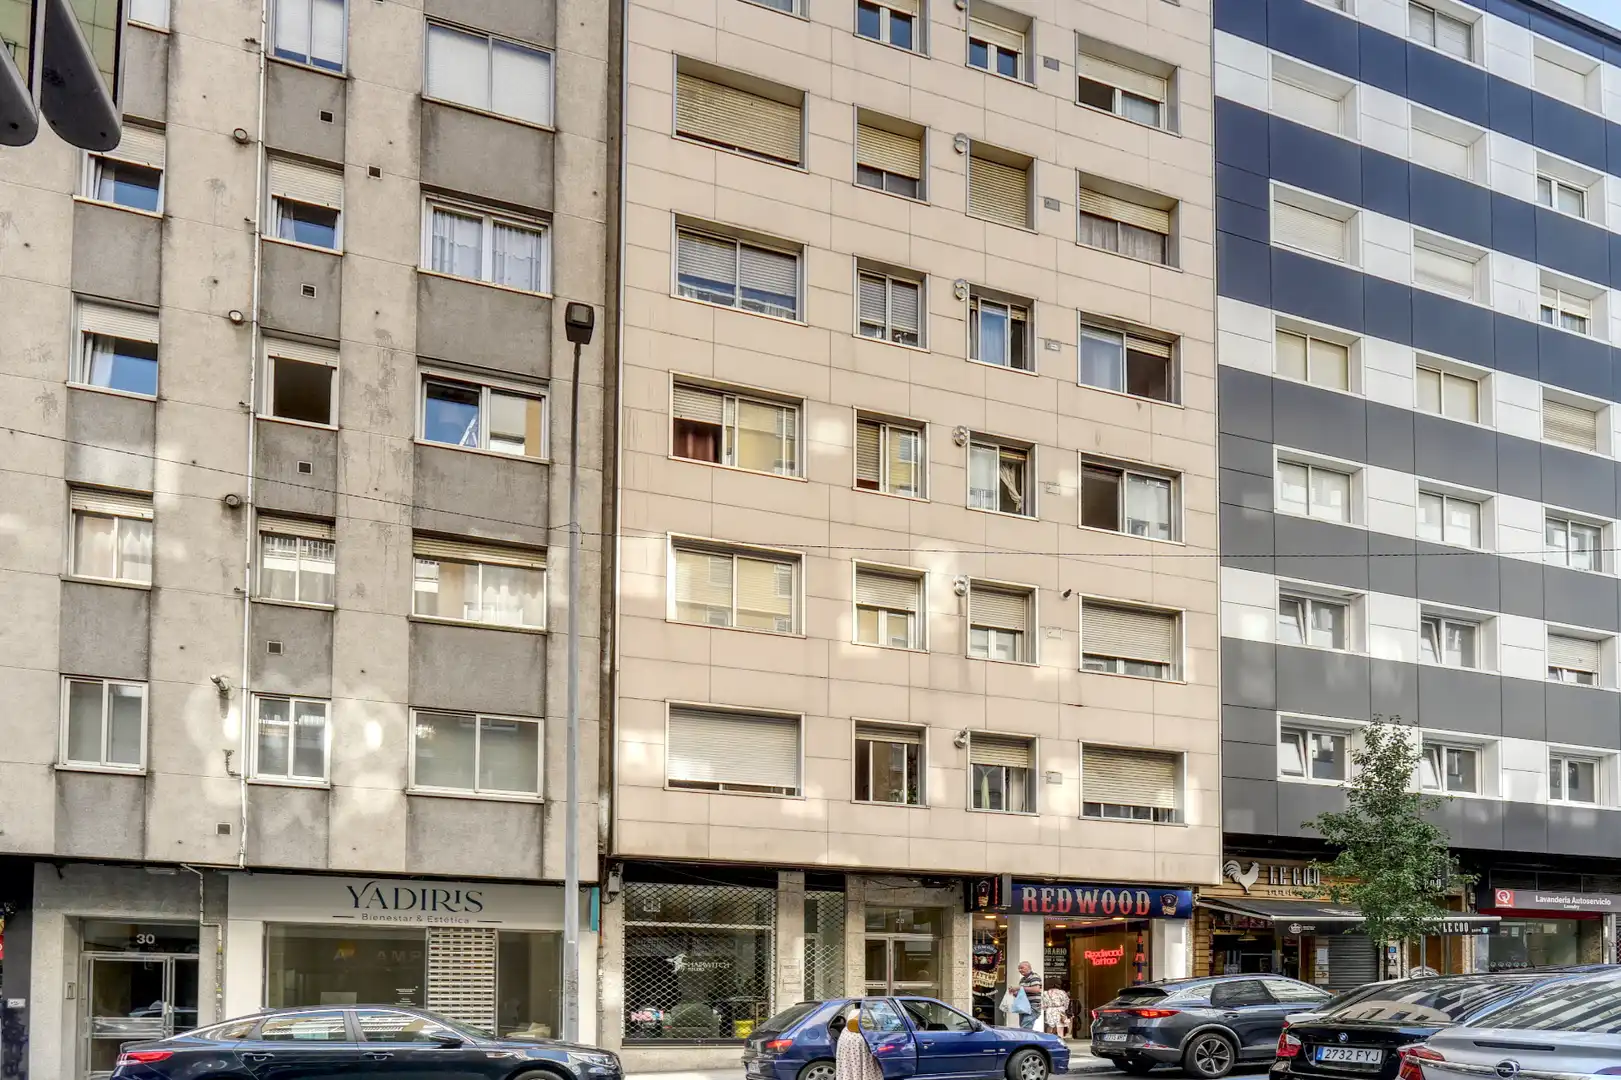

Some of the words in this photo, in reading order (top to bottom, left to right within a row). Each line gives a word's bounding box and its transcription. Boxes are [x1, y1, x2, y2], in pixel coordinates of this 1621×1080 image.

[1269, 865, 1287, 885] LE
[346, 880, 484, 913] YADIRIS
[1021, 886, 1151, 916] REDWOOD
[1571, 896, 1612, 906] Autoservicio
[361, 913, 413, 922] Bienestar
[416, 915, 423, 923] &
[1443, 922, 1453, 933] LE
[136, 933, 156, 944] 30
[1084, 944, 1124, 960] Redwood
[1324, 1048, 1353, 1060] 2732
[1355, 1050, 1379, 1062] FYJ
